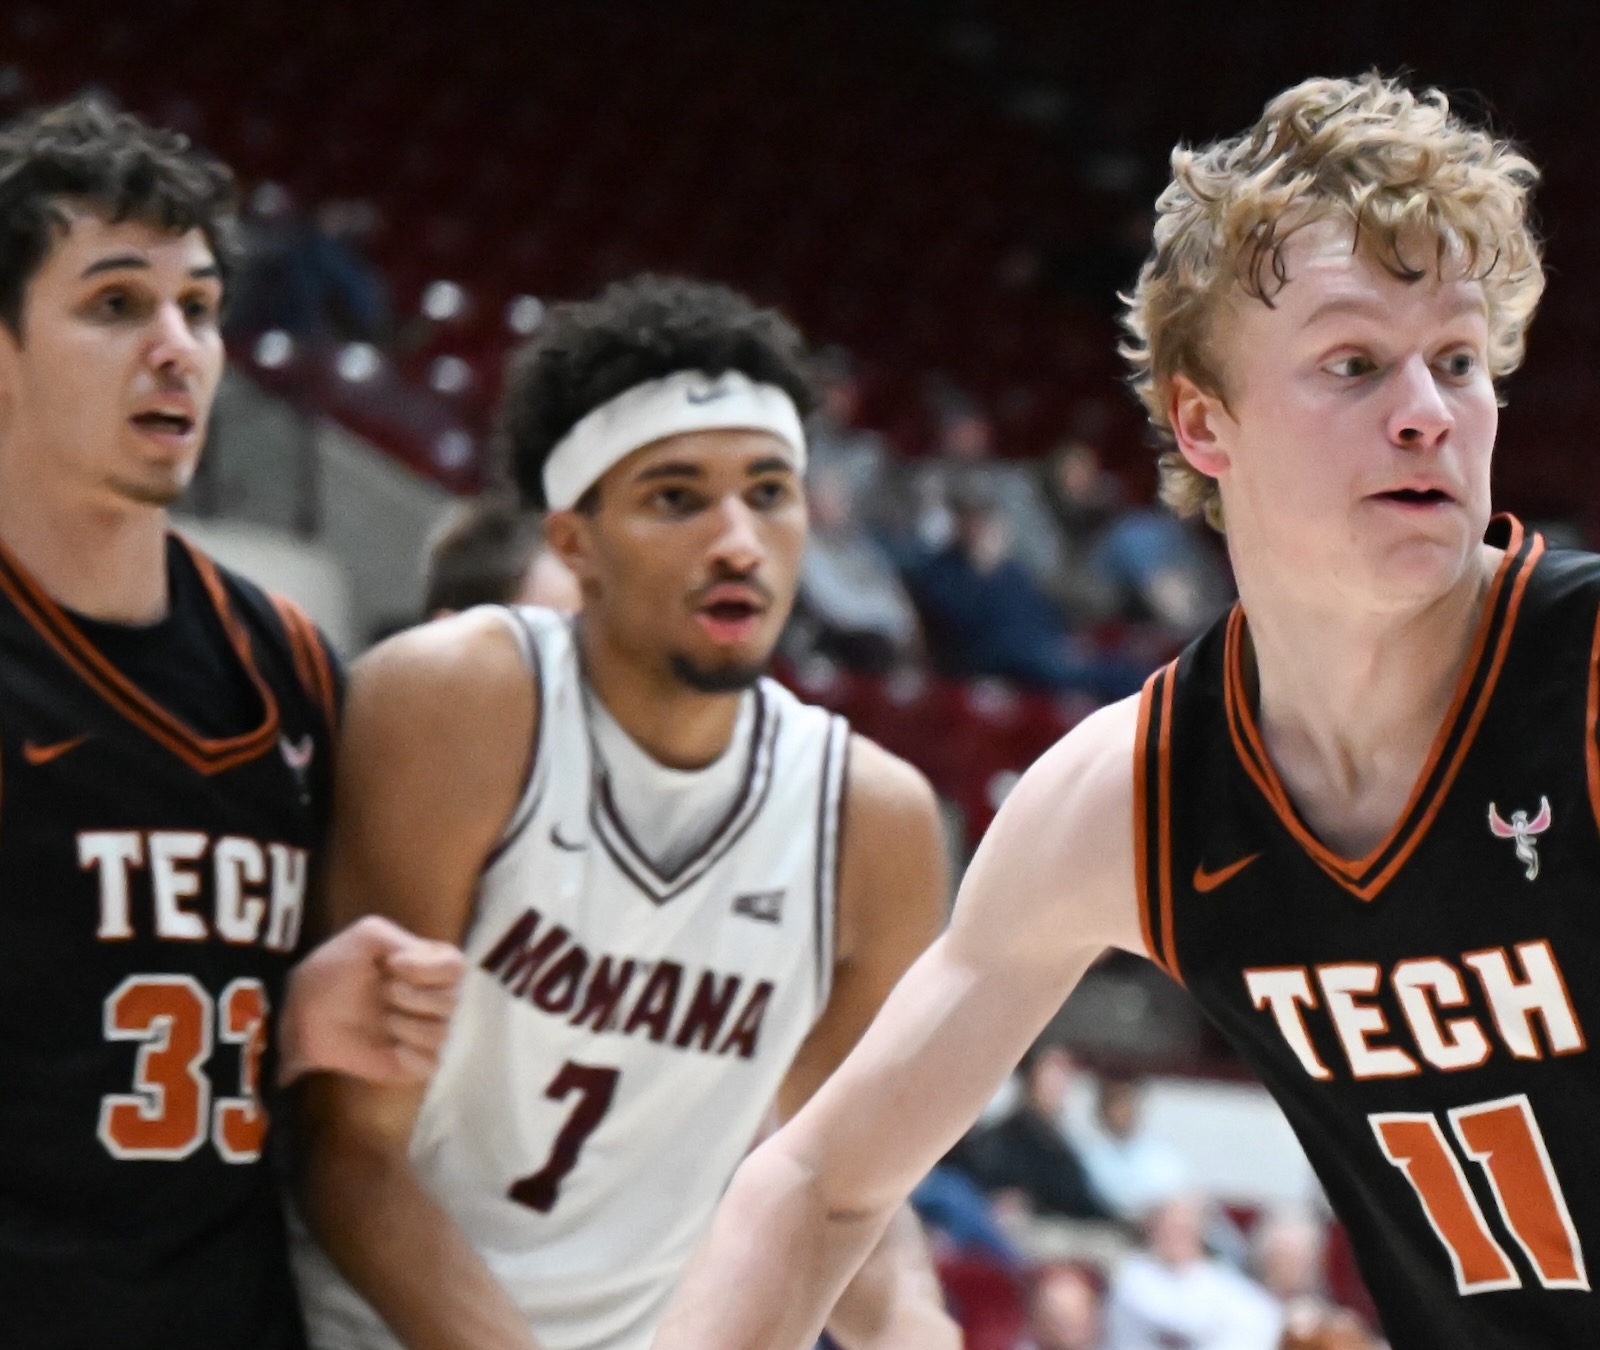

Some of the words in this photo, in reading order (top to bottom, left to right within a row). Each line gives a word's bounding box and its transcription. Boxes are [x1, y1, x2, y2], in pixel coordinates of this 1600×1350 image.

[76, 831, 308, 952] TECH
[480, 906, 775, 1059] MONANA
[1242, 939, 1587, 1081] TECH
[507, 1061, 623, 1214] 7
[1367, 1094, 1591, 1296] 11
